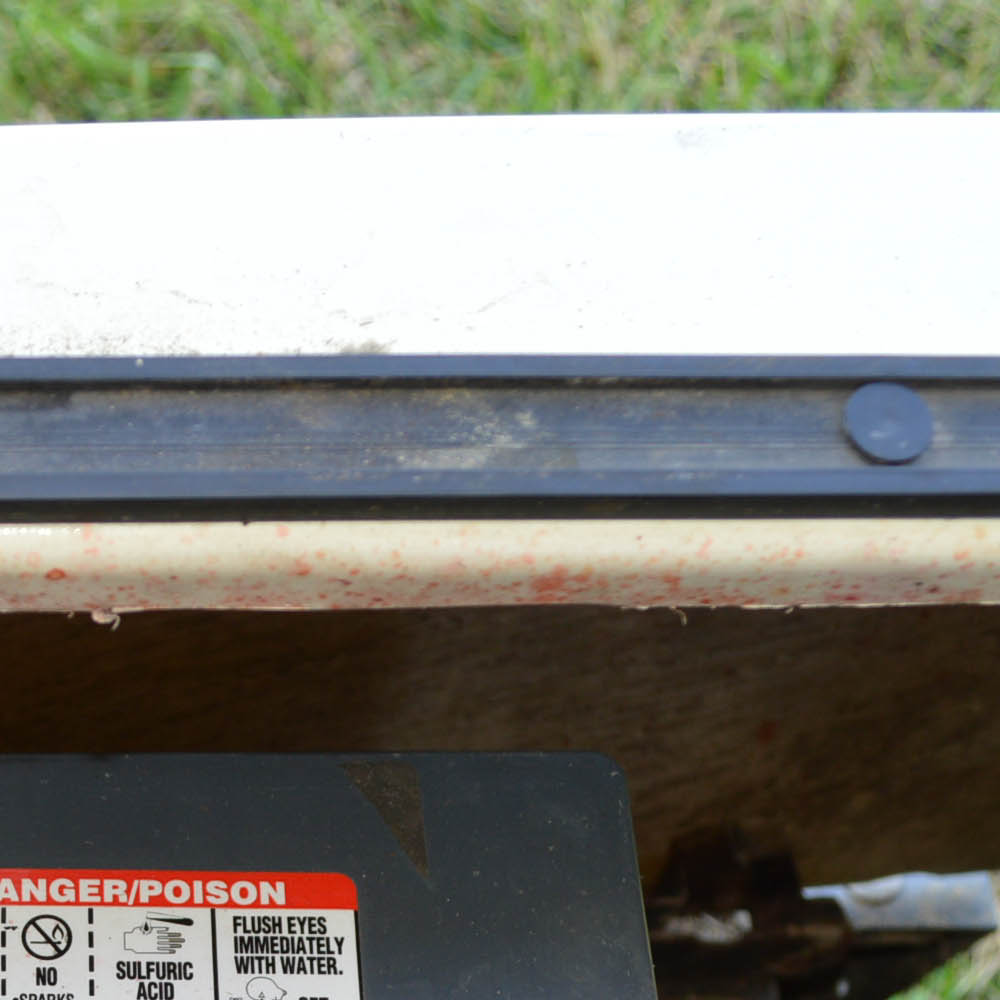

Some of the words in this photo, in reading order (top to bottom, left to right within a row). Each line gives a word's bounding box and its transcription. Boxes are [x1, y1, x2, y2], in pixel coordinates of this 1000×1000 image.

[232, 916, 283, 934] FLUSH
[287, 916, 327, 935] EYES
[234, 936, 345, 955] IMMEDIATELY
[116, 961, 194, 981] SULFURIC
[234, 956, 276, 975] WITH
[281, 957, 344, 976] WATER.
[35, 967, 58, 987] NO
[136, 982, 175, 1000] ACID
